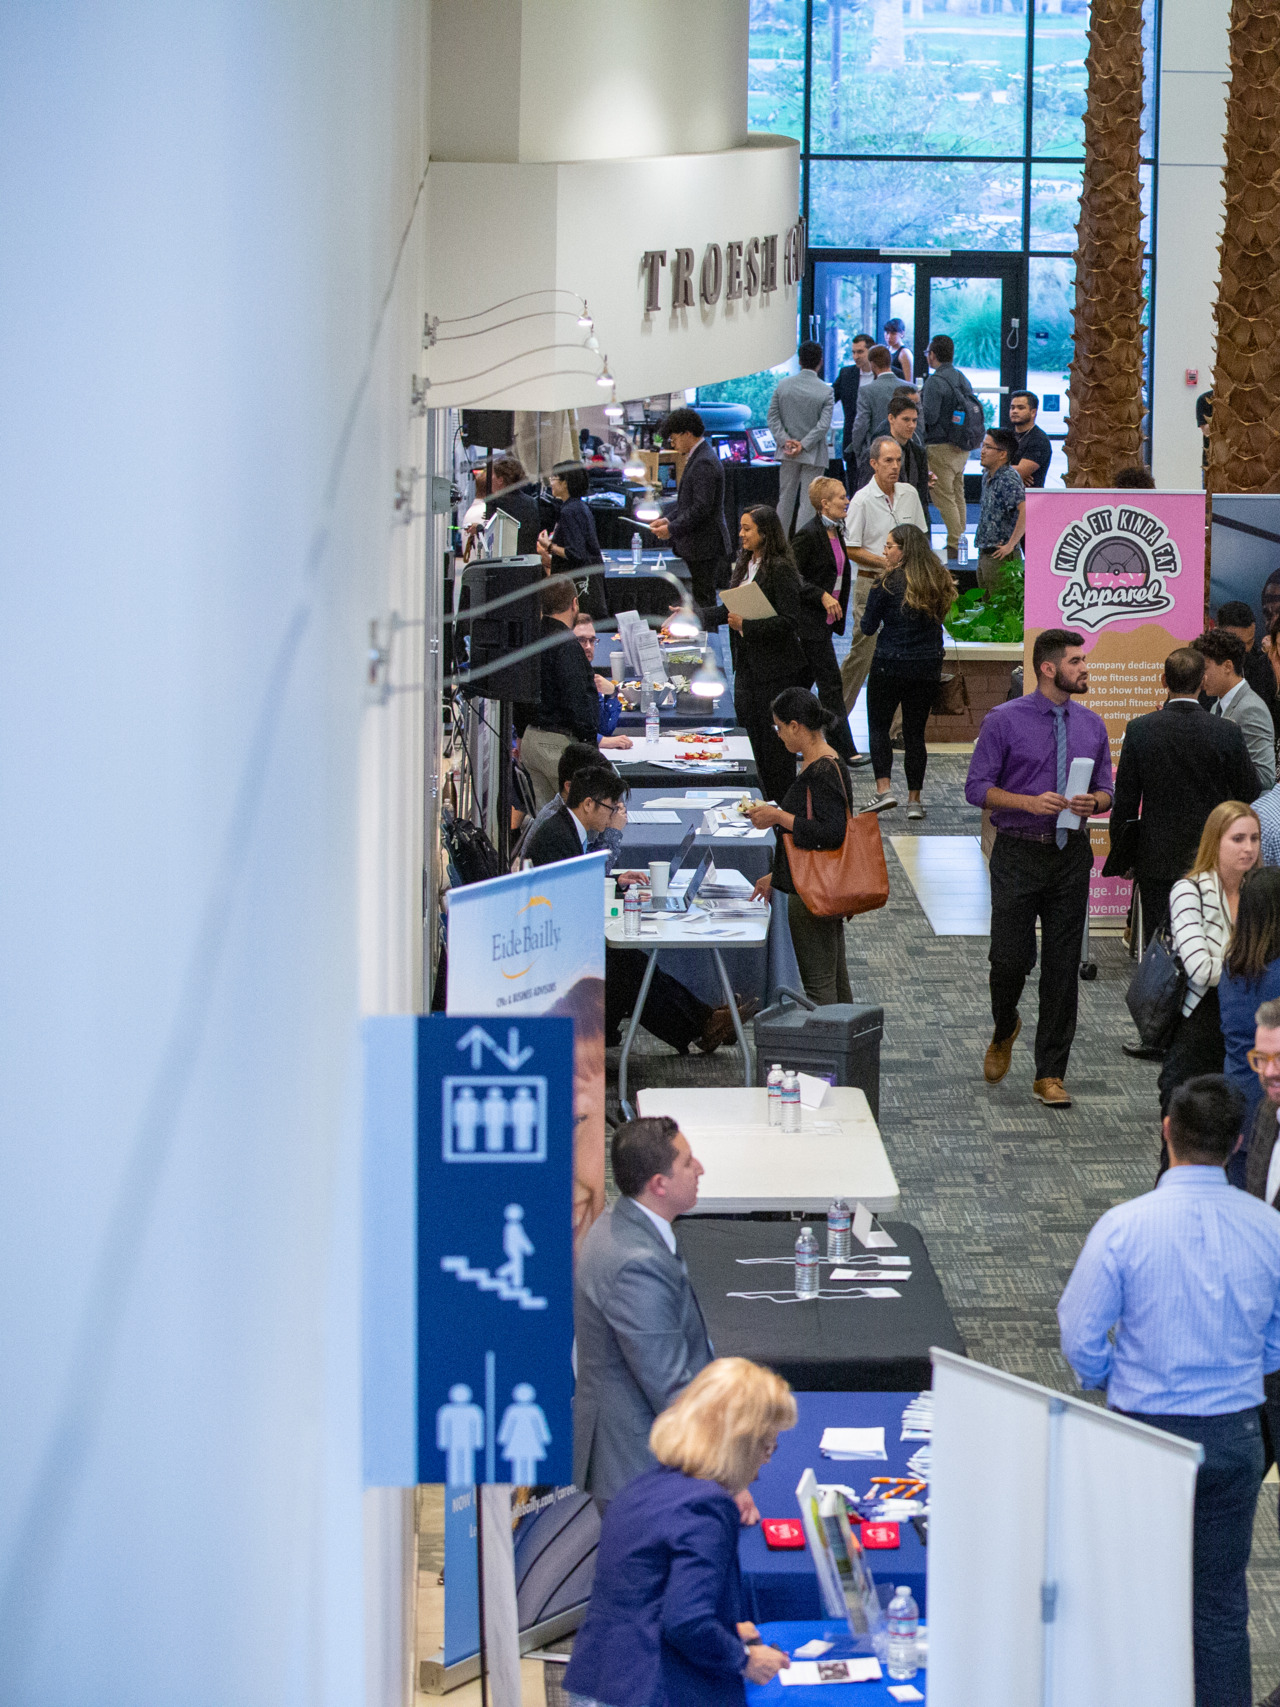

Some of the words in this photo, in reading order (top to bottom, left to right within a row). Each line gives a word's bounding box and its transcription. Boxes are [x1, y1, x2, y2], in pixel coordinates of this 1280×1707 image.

[643, 234, 778, 311] TROESH
[1056, 527, 1091, 571] KINDA
[1088, 511, 1112, 535] FIT
[1118, 510, 1163, 546] KINDA
[1153, 544, 1176, 572] FAT
[1063, 580, 1160, 608] Apparel
[1086, 662, 1125, 670] company
[1128, 661, 1164, 669] dedicate
[1089, 674, 1107, 682] love
[1109, 674, 1138, 682] fitness
[1140, 674, 1156, 682] and
[1089, 686, 1095, 694] is
[1109, 686, 1132, 694] show
[1134, 686, 1152, 694] that
[1089, 699, 1126, 707] personal
[1129, 699, 1156, 707] fitness
[1104, 712, 1130, 720] eating
[1089, 887, 1111, 898] age.
[1115, 885, 1131, 896] Joi
[492, 929, 522, 961] Eide
[524, 919, 560, 951] Bailly
